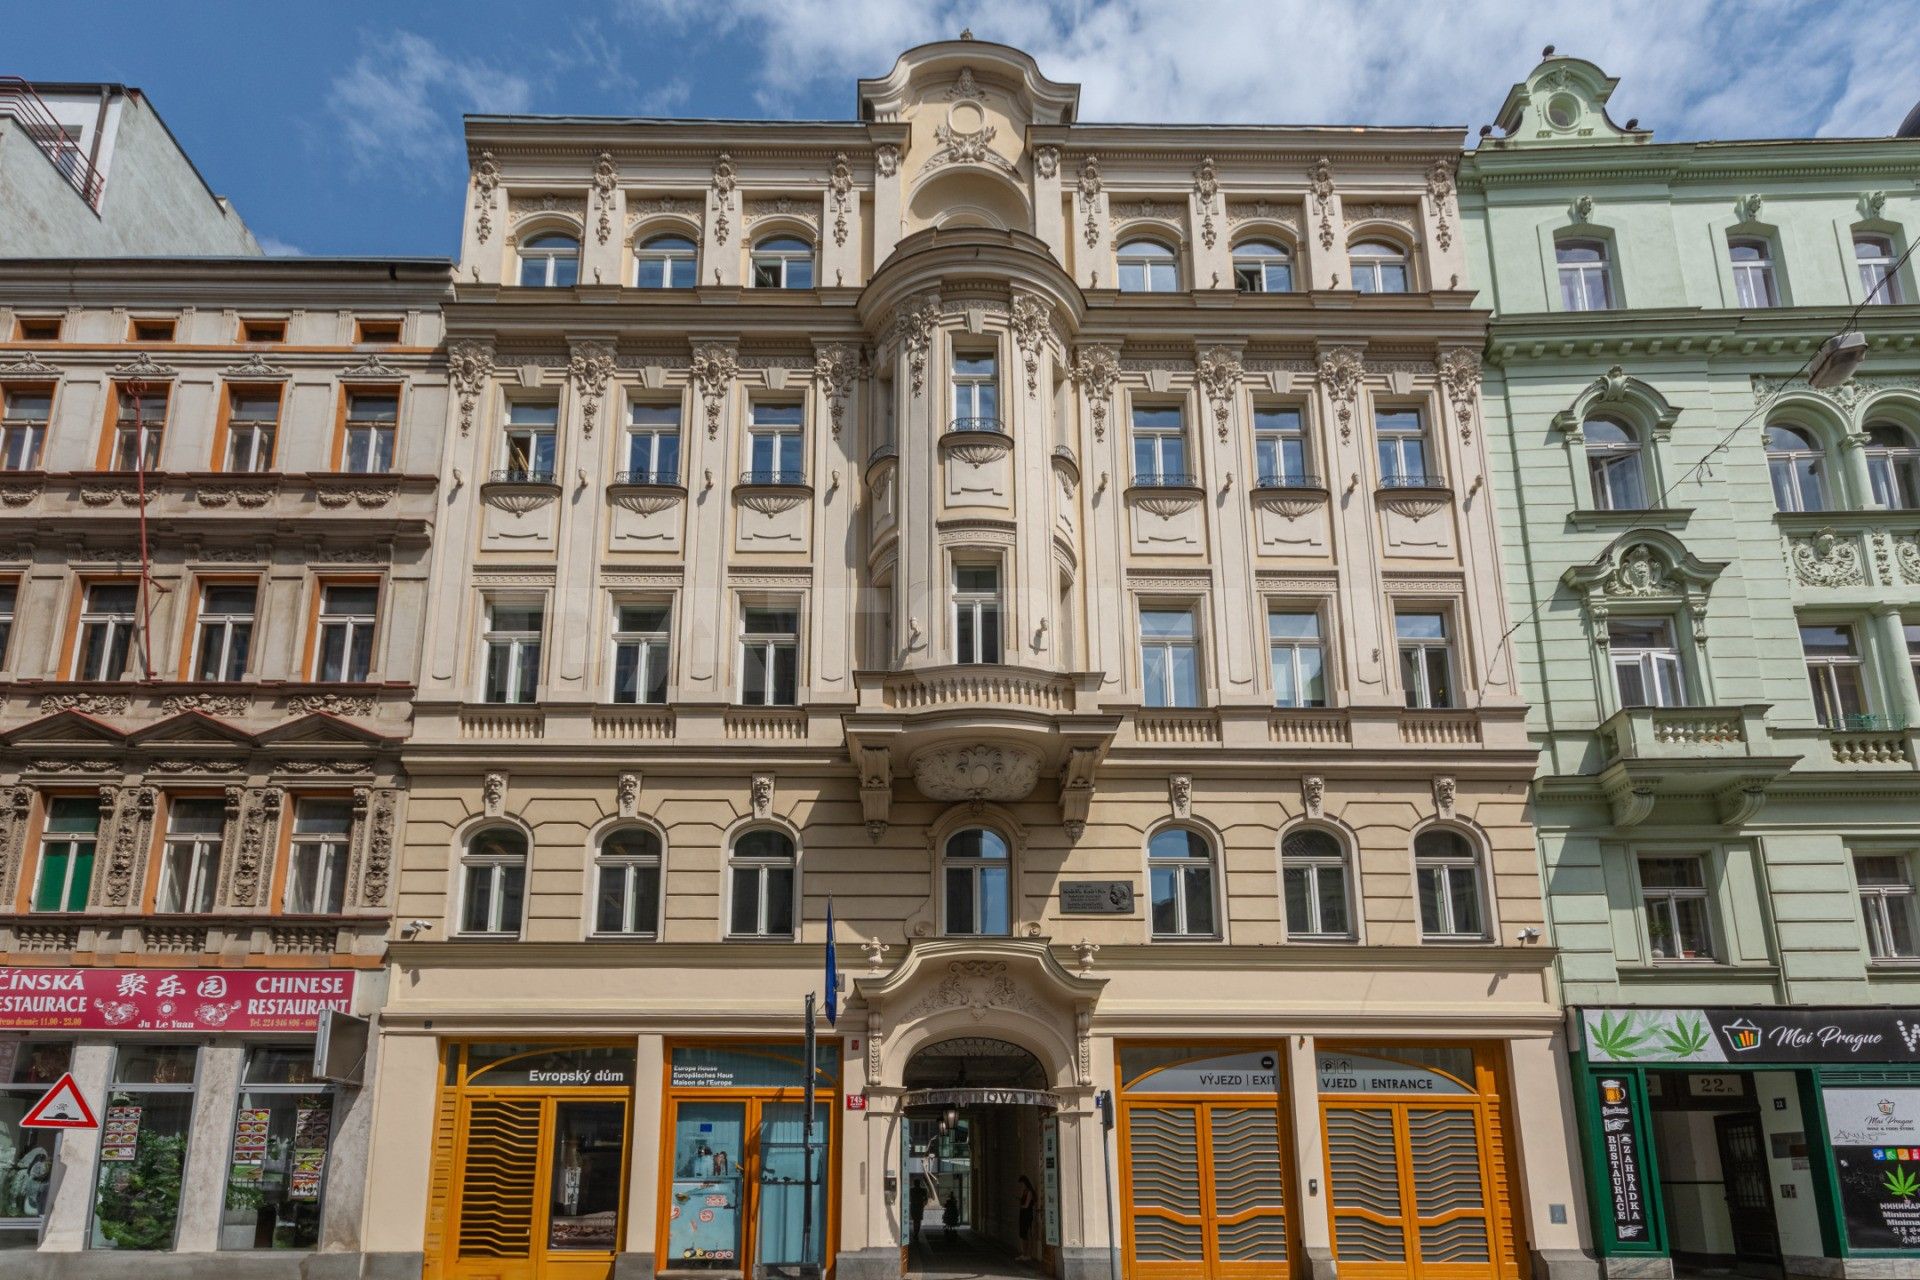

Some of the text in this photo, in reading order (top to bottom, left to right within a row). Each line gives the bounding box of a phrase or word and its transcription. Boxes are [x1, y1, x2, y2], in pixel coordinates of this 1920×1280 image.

[0, 970, 84, 990] ČÍNSKÁ
[255, 976, 344, 994] CHINESE
[247, 999, 349, 1015] RESTAURANT
[138, 1020, 194, 1028] Ju Le Yuan
[1769, 1026, 1884, 1053] Mai Prague
[529, 1069, 624, 1085] Evropský dům
[1199, 1072, 1277, 1086] VÝJEZD EXIT
[1321, 1078, 1433, 1090] VJEZD ENTRANCE
[1700, 1078, 1726, 1093] 22
[1607, 1135, 1626, 1220] RESTAURACE
[1623, 1145, 1640, 1220] ZAHRÁDKA
